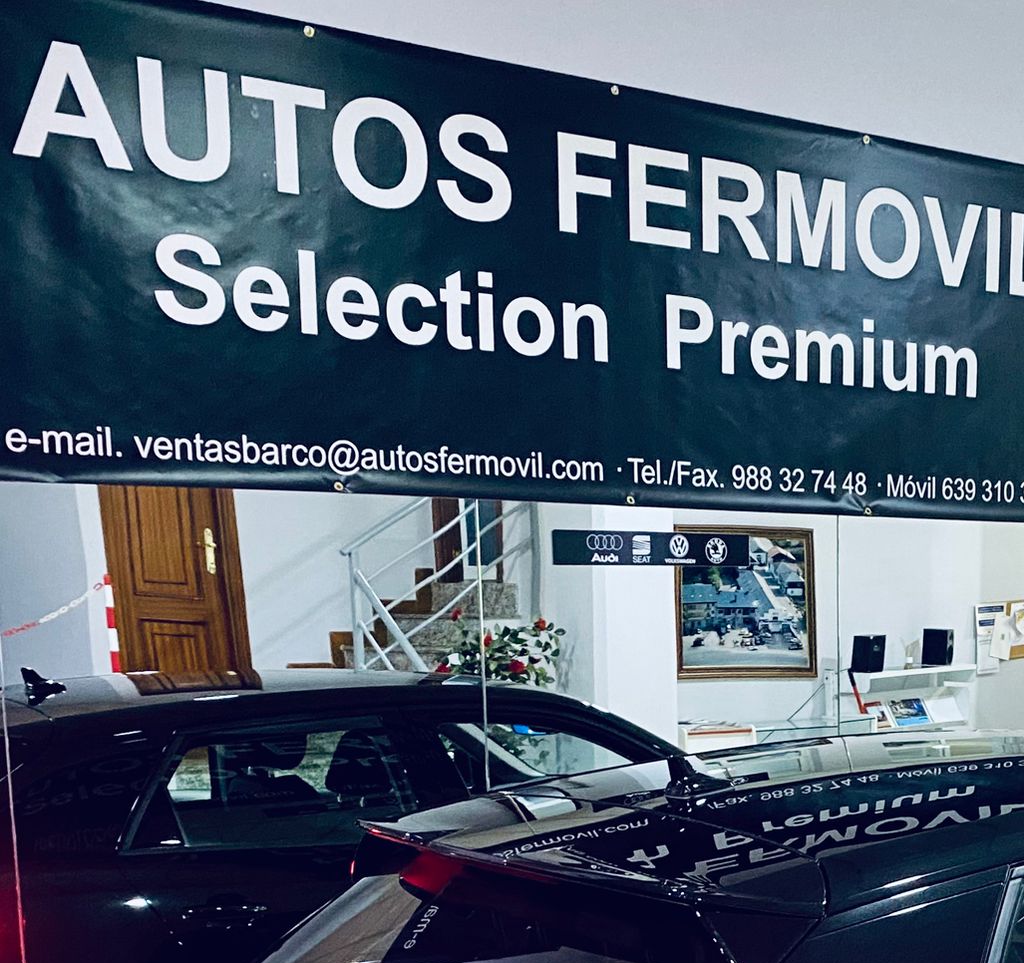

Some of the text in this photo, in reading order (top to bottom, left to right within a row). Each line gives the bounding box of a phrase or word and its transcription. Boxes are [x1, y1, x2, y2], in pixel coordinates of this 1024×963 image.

[13, 40, 512, 222] AUTOS
[154, 233, 978, 398] Selection Premium
[5, 425, 123, 458] e-mail.
[133, 432, 604, 482] ventasbarco@autosfermovil.com
[731, 464, 773, 491] 988
[779, 467, 805, 493] 32
[811, 469, 837, 494] 74
[841, 471, 867, 496] 48
[886, 473, 936, 499] Móvil
[941, 477, 976, 501] 639
[981, 479, 1015, 503] 310
[591, 552, 619, 563] Audi
[632, 555, 652, 564] SEAT
